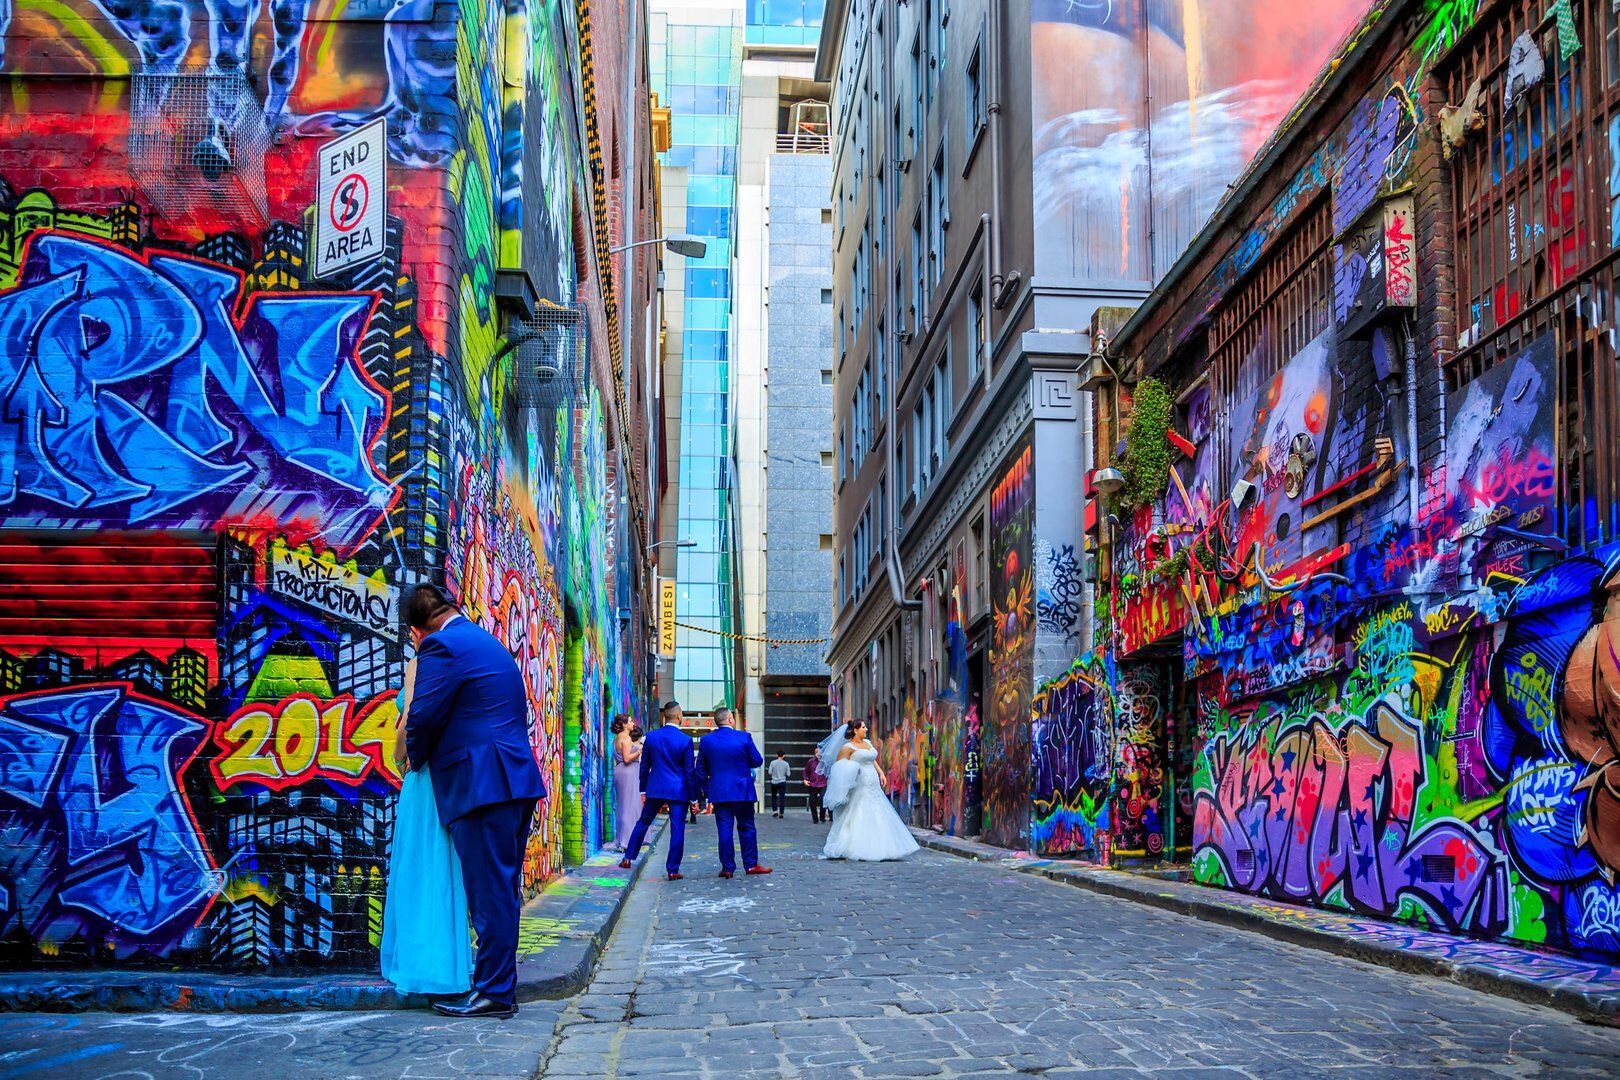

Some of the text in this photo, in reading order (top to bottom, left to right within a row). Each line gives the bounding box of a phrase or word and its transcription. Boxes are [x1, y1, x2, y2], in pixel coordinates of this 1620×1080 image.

[330, 141, 370, 176] END
[324, 226, 373, 263] AREA
[663, 585, 673, 650] ZAMBESI
[213, 692, 404, 784] 2014
